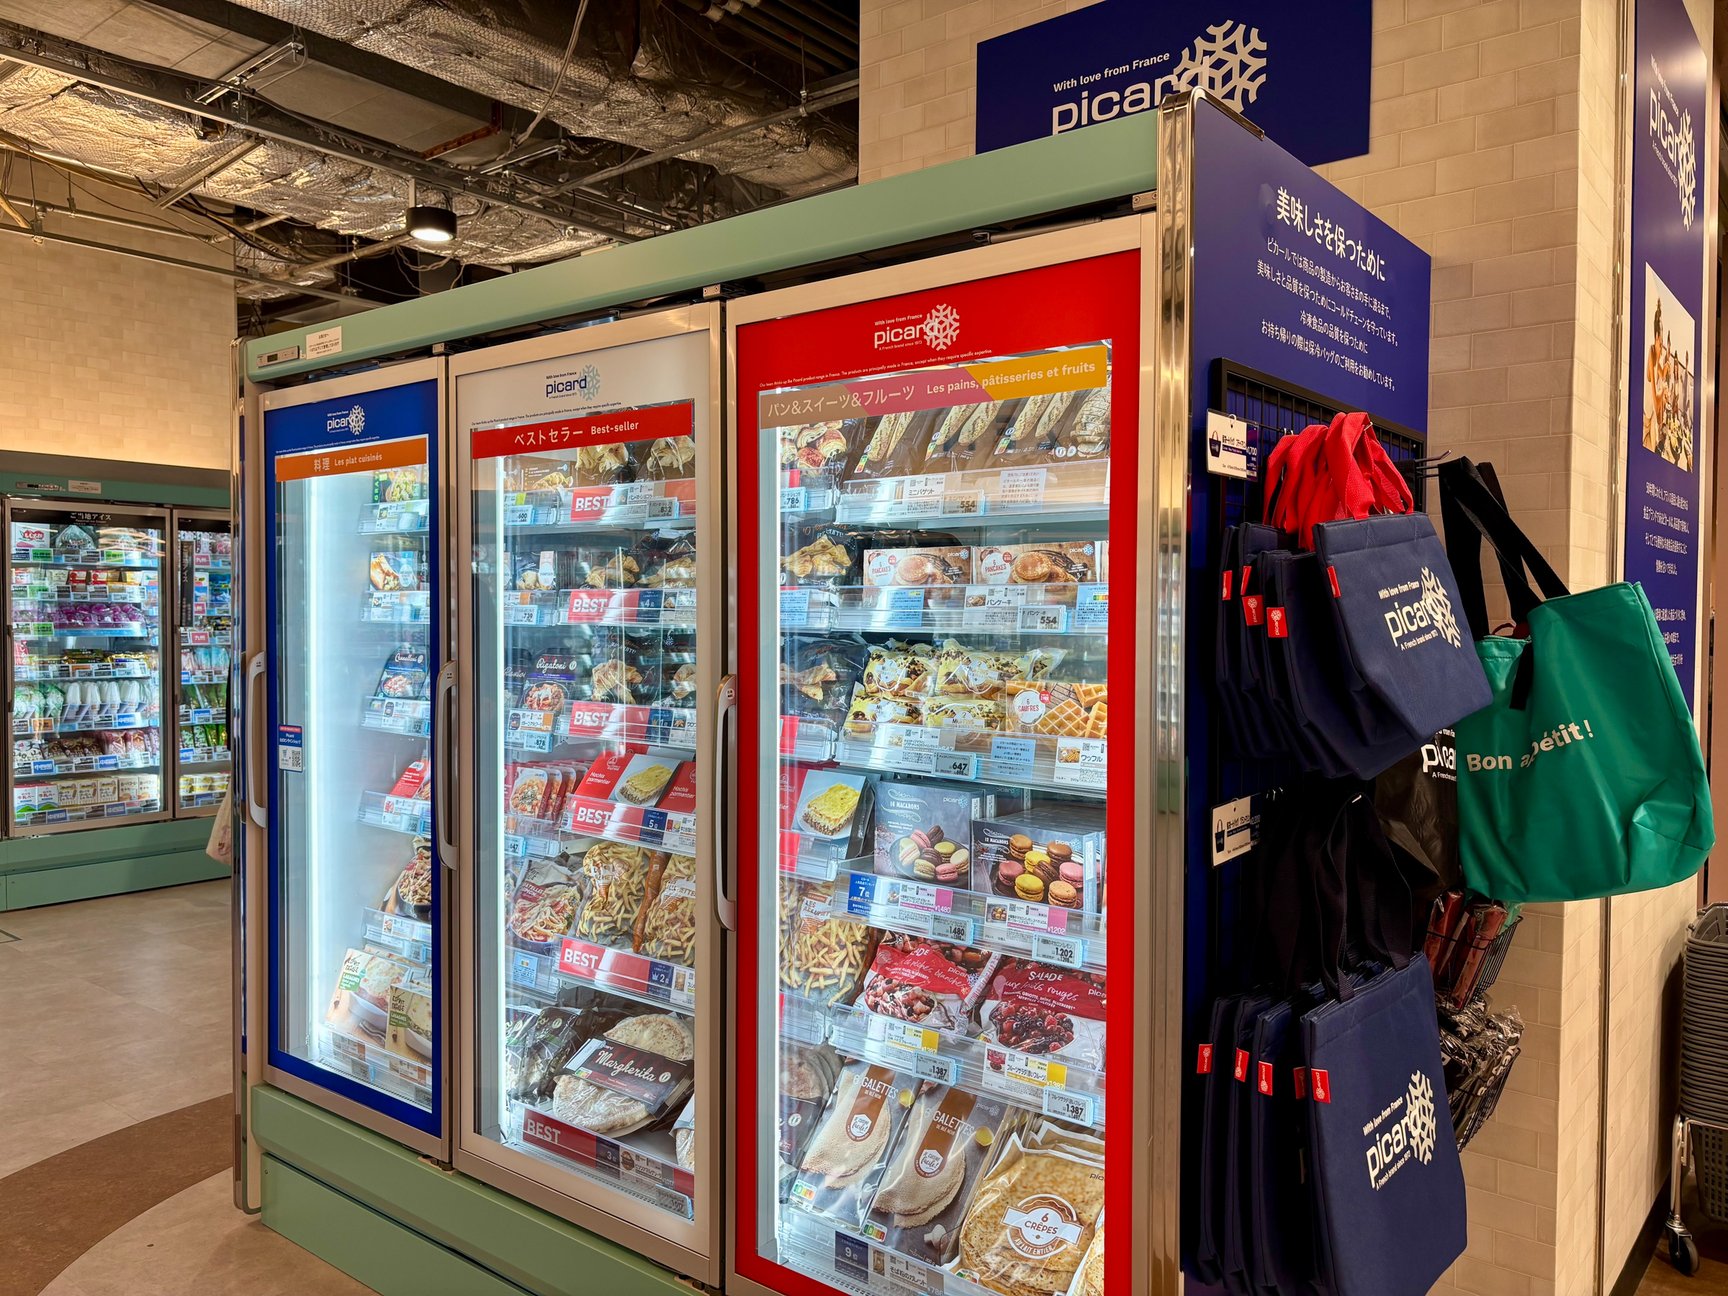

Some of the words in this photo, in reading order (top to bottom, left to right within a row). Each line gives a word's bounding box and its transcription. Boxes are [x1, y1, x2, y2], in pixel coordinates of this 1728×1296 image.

[1053, 77, 1077, 93] With
[1080, 72, 1101, 86] love
[1104, 64, 1129, 78] from
[1132, 52, 1170, 70] France
[1277, 186, 1386, 282] 美味しさを保つために
[874, 318, 939, 349] picard
[1300, 310, 1369, 354] 冷凍食品の品質を保つために
[927, 381, 945, 395] Les
[947, 376, 979, 396] pains,
[982, 367, 1044, 390] pâtisseries
[1046, 366, 1059, 378] et
[1062, 360, 1096, 377] fruits
[546, 375, 587, 398] picard
[514, 426, 583, 446] ベストセラー
[591, 420, 640, 436] Best-seller
[314, 457, 330, 472] 料理
[334, 457, 345, 467] Les
[345, 456, 357, 469] plat
[358, 453, 383, 465] cuisinés
[575, 496, 609, 512] BEST
[960, 500, 976, 508] 554
[70, 512, 112, 521] ご当地アイス
[985, 564, 1007, 573] PANCAKES
[572, 598, 608, 613] BEST
[1040, 616, 1058, 625] 554
[1018, 704, 1039, 713] GAUFRES
[573, 711, 609, 727] BEST
[1466, 753, 1513, 772] Bon
[1583, 719, 1594, 738] !
[952, 761, 968, 771] 647
[1080, 754, 1103, 763] ワッフル
[577, 807, 612, 826] BEST
[563, 947, 598, 969] BEST
[1028, 970, 1064, 982] SALADE
[1047, 986, 1079, 1002] rouges
[595, 1049, 656, 1083] Margherita
[861, 1076, 899, 1100] GALETTES
[933, 1110, 975, 1135] GALETTES
[526, 1119, 561, 1145] BEST
[1366, 1100, 1421, 1189] picard
[1041, 1212, 1050, 1222] 6
[1024, 1220, 1059, 1235] CRÊPES
